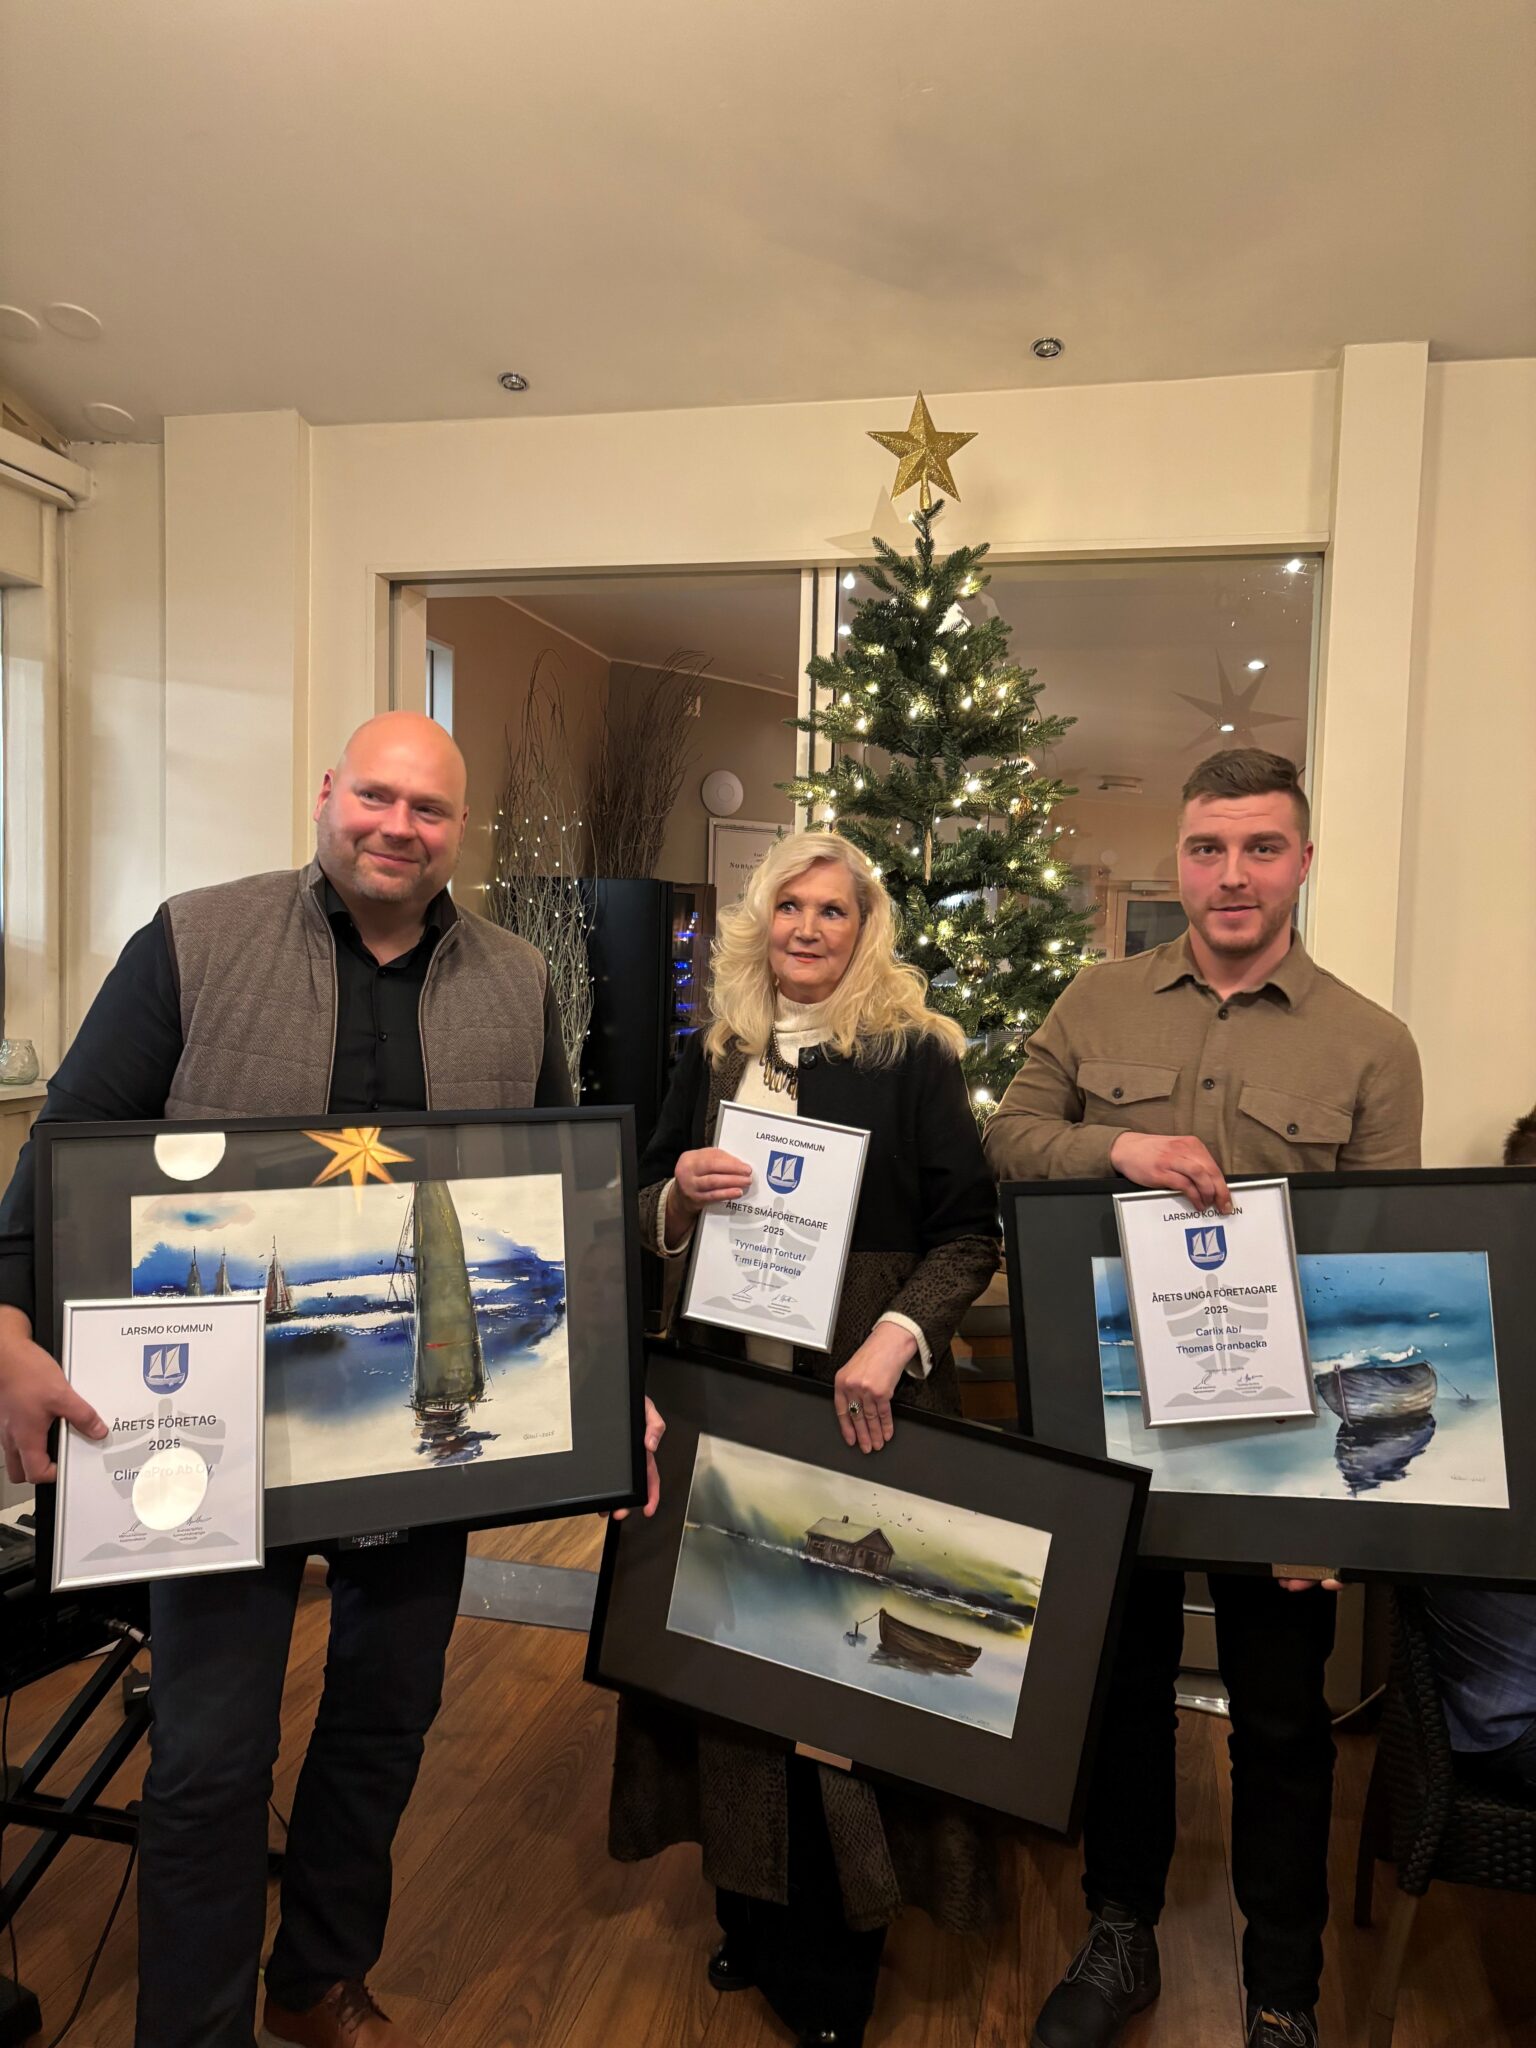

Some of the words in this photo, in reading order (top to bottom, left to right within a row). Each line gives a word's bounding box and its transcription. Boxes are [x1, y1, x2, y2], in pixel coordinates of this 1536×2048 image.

[756, 1132, 788, 1145] LARSMO
[789, 1139, 825, 1152] KOMMUN
[754, 1207, 828, 1230] SMÅFÖRETAGARE
[1163, 1211, 1200, 1221] LARSMO
[1201, 1207, 1242, 1218] KOMUN
[763, 1225, 784, 1236] 2025
[735, 1239, 772, 1254] Tyynelän
[734, 1254, 752, 1265] T:mi
[753, 1258, 768, 1269] Eija
[770, 1263, 801, 1276] Porkola
[1152, 1292, 1183, 1303] ÅRETS
[1184, 1289, 1212, 1300] UNGA
[1214, 1284, 1278, 1298] FÖRETAGARE
[1204, 1305, 1228, 1315] 2025
[121, 1326, 164, 1336] LARSMO
[166, 1323, 213, 1333] KOMMUN
[1195, 1326, 1223, 1337] Carlix
[1226, 1324, 1242, 1334] Ab/
[1176, 1343, 1214, 1354] Thomas
[1216, 1339, 1267, 1351] Granbacka
[112, 1417, 155, 1432] ÅRETS
[158, 1415, 217, 1429] FÖRETAG
[149, 1438, 181, 1451] 2025
